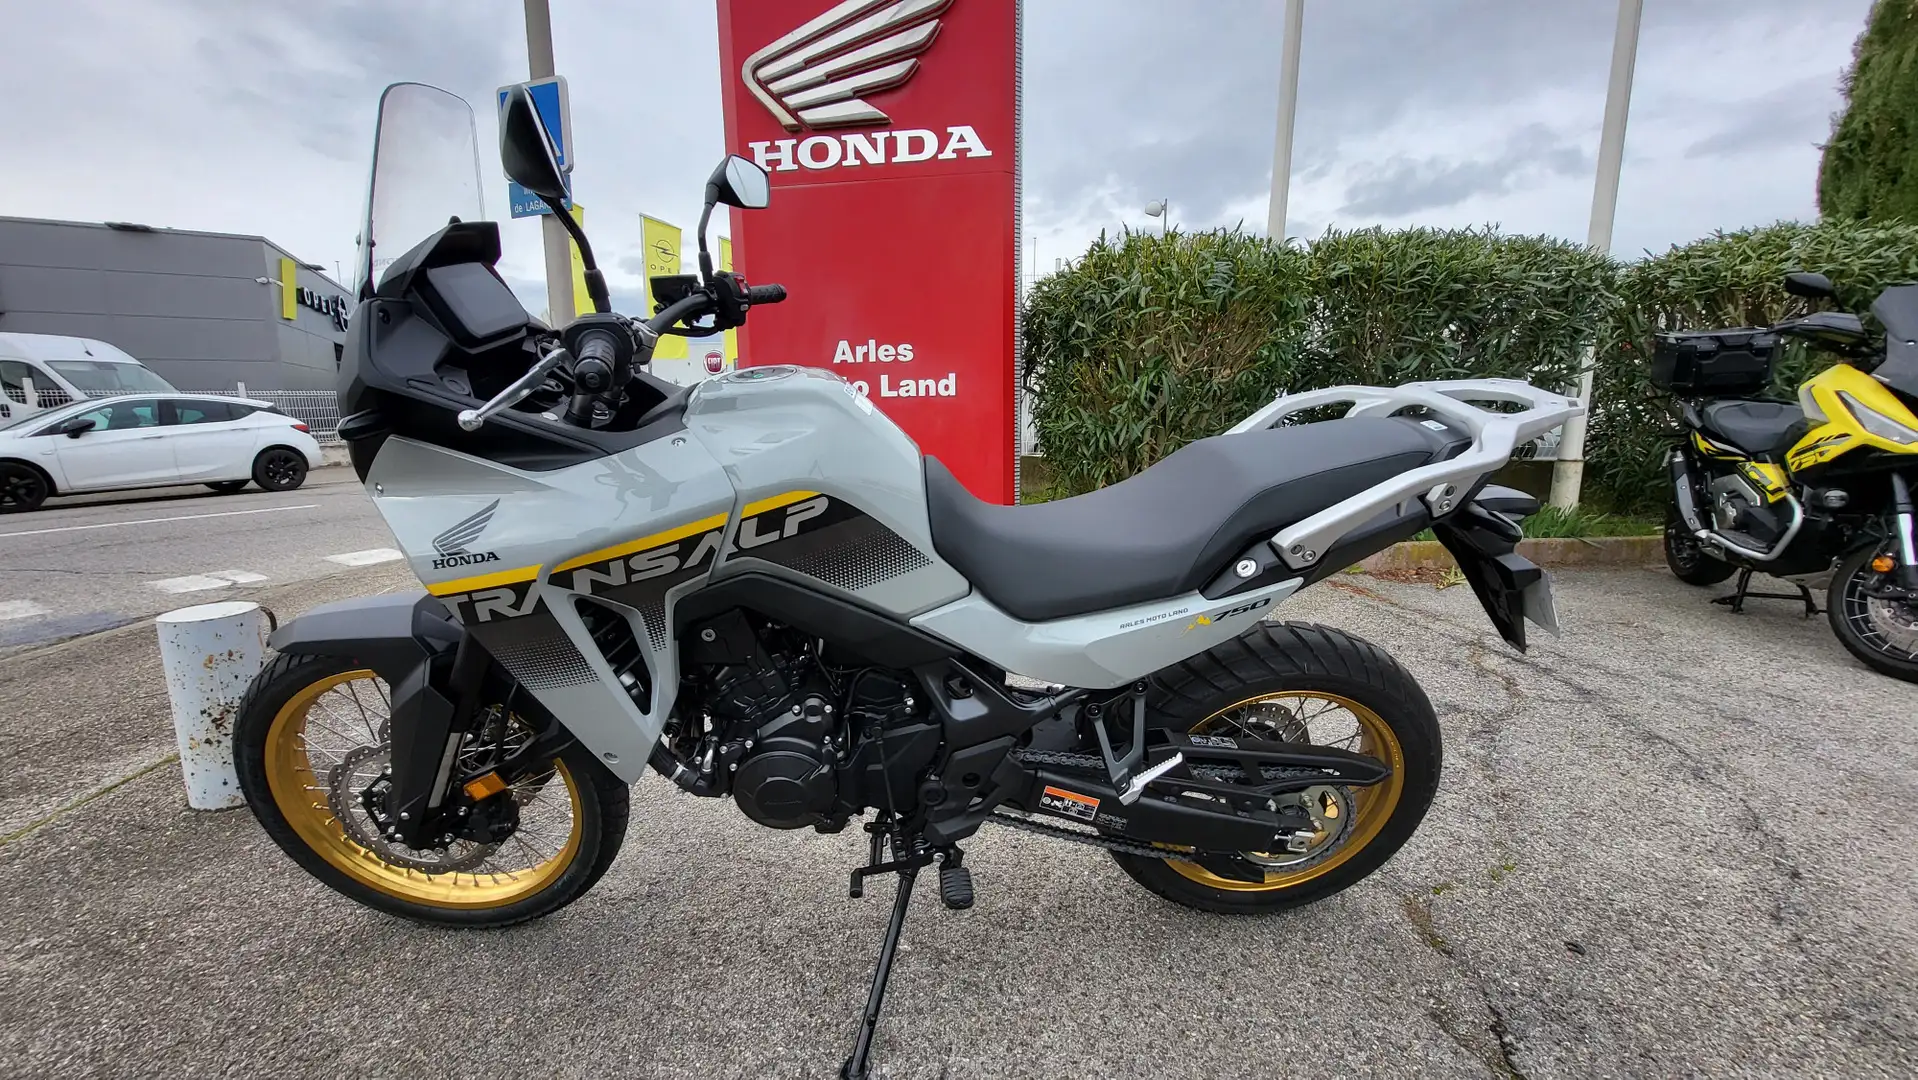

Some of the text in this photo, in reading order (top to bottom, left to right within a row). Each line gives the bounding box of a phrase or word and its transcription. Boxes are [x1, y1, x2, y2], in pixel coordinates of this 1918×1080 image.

[749, 125, 993, 172] HONDA
[514, 203, 523, 213] de
[303, 286, 335, 317] OPEL
[833, 339, 915, 363] Arles
[880, 372, 957, 398] Land
[432, 551, 502, 570] HONDA
[1119, 607, 1189, 630] ARLES MOTO LAND
[1212, 597, 1272, 624] 750
